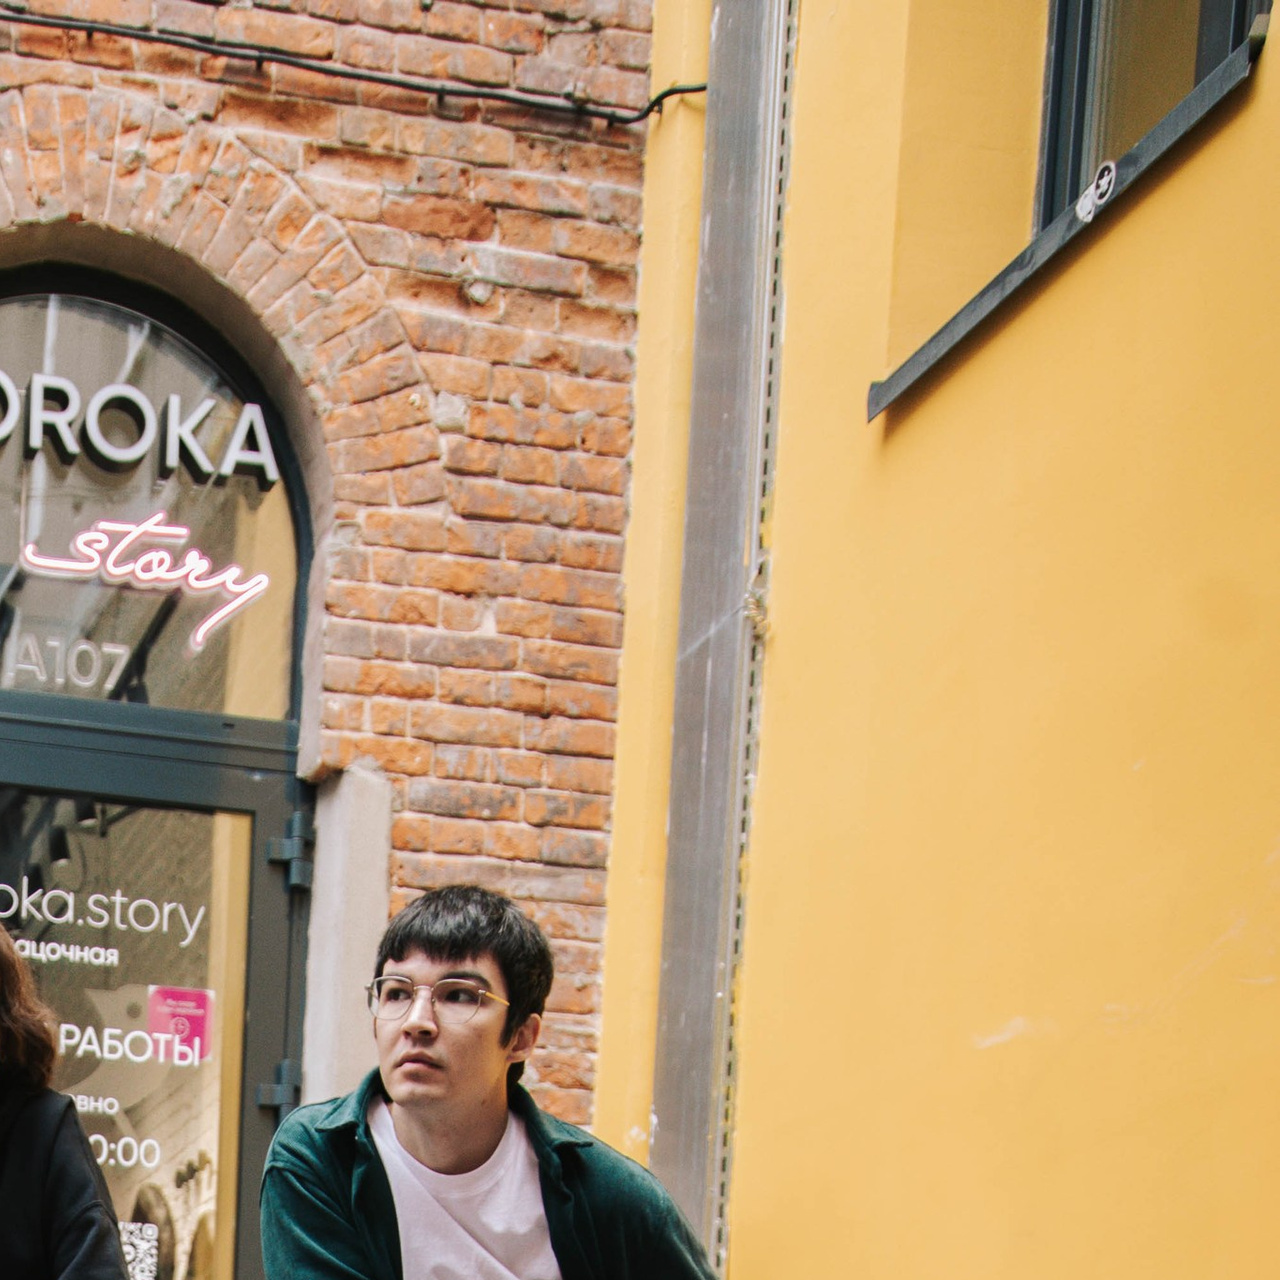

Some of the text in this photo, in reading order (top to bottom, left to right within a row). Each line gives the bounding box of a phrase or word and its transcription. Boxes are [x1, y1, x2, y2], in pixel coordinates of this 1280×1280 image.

[22, 511, 269, 654] story
[13, 633, 132, 691] A107
[13, 938, 119, 967] ацочная
[59, 1023, 200, 1067] РАБОТЫ
